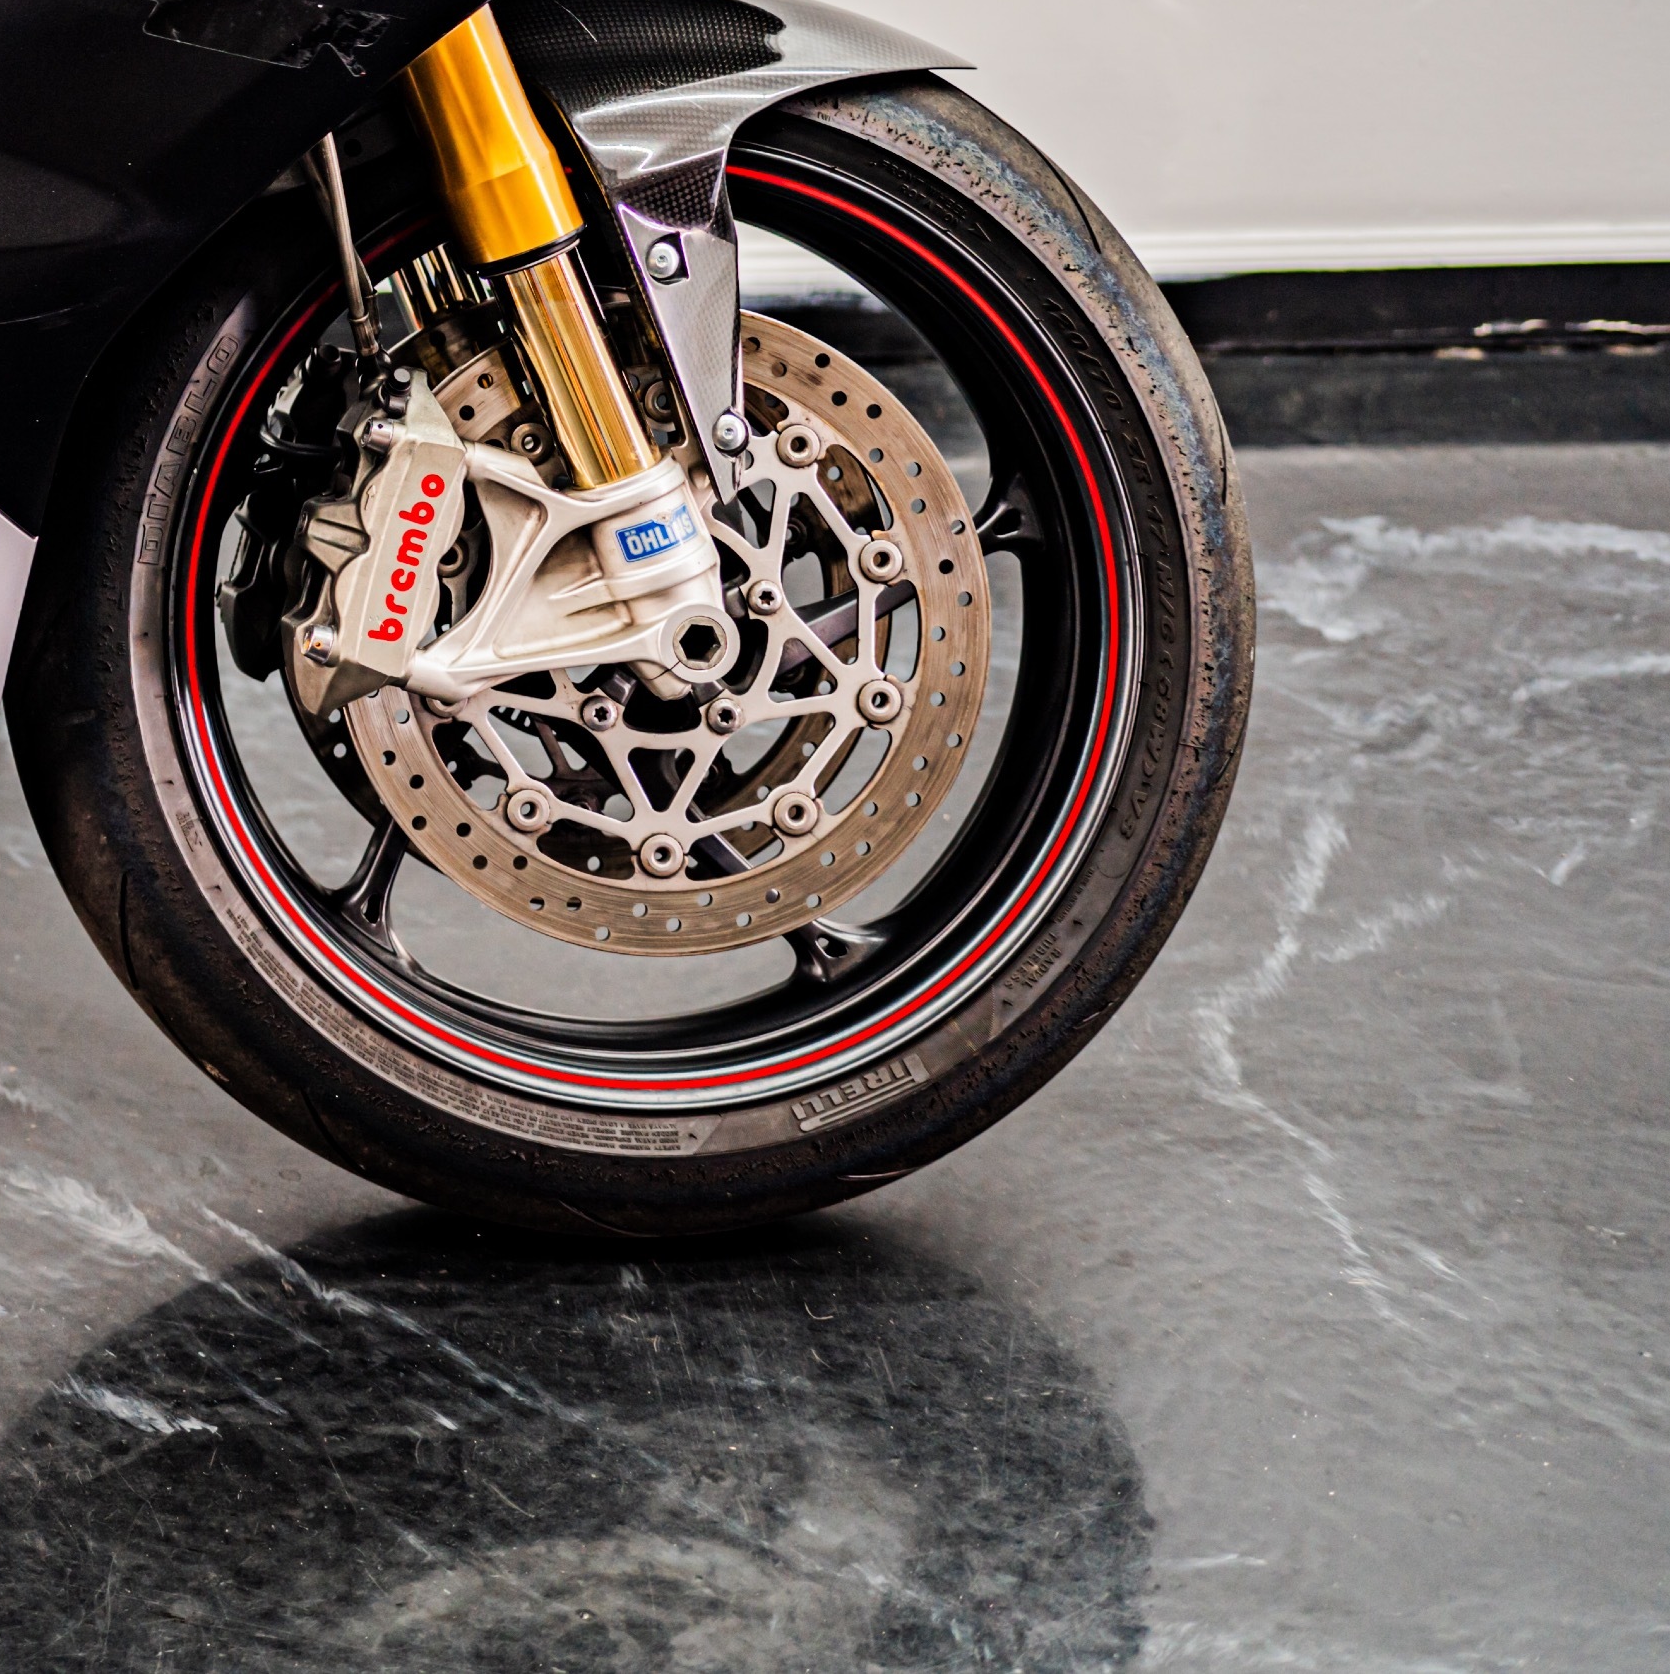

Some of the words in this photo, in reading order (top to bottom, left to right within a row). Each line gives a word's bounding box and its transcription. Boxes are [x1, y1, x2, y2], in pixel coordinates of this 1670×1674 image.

[136, 333, 240, 566] DIABLO
[367, 473, 446, 642] brembo
[1002, 929, 1061, 993] TUBELESS
[1021, 944, 1064, 991] RADIAL
[791, 1054, 931, 1132] PIRELLI
